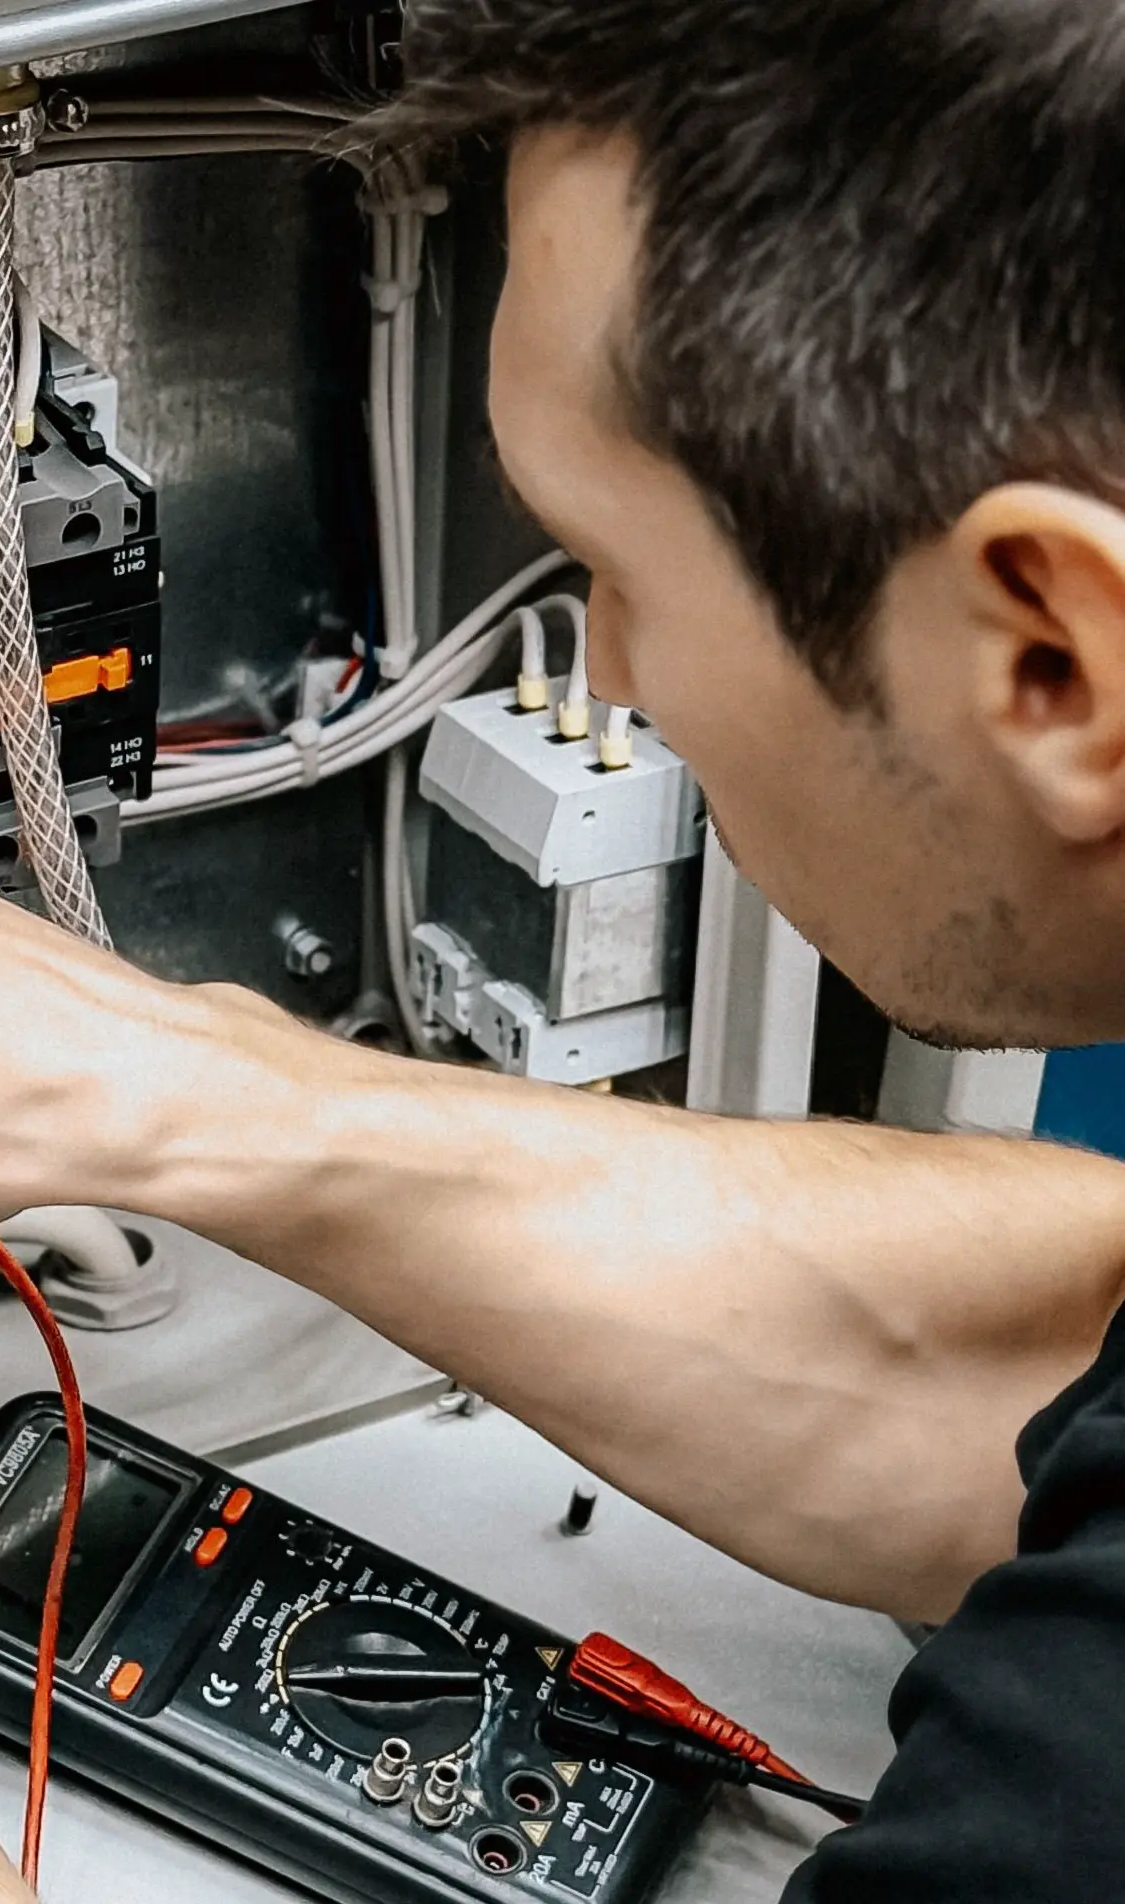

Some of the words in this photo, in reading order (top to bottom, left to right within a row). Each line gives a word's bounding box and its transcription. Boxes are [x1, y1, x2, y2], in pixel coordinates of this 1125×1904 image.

[110, 742, 122, 754] 14
[218, 1625, 239, 1652] AUTO
[232, 1595, 258, 1629] POWER
[250, 1578, 266, 1597] OFF
[95, 1653, 122, 1691] POWER
[561, 1801, 586, 1829] mA
[528, 1854, 556, 1886] 20A
